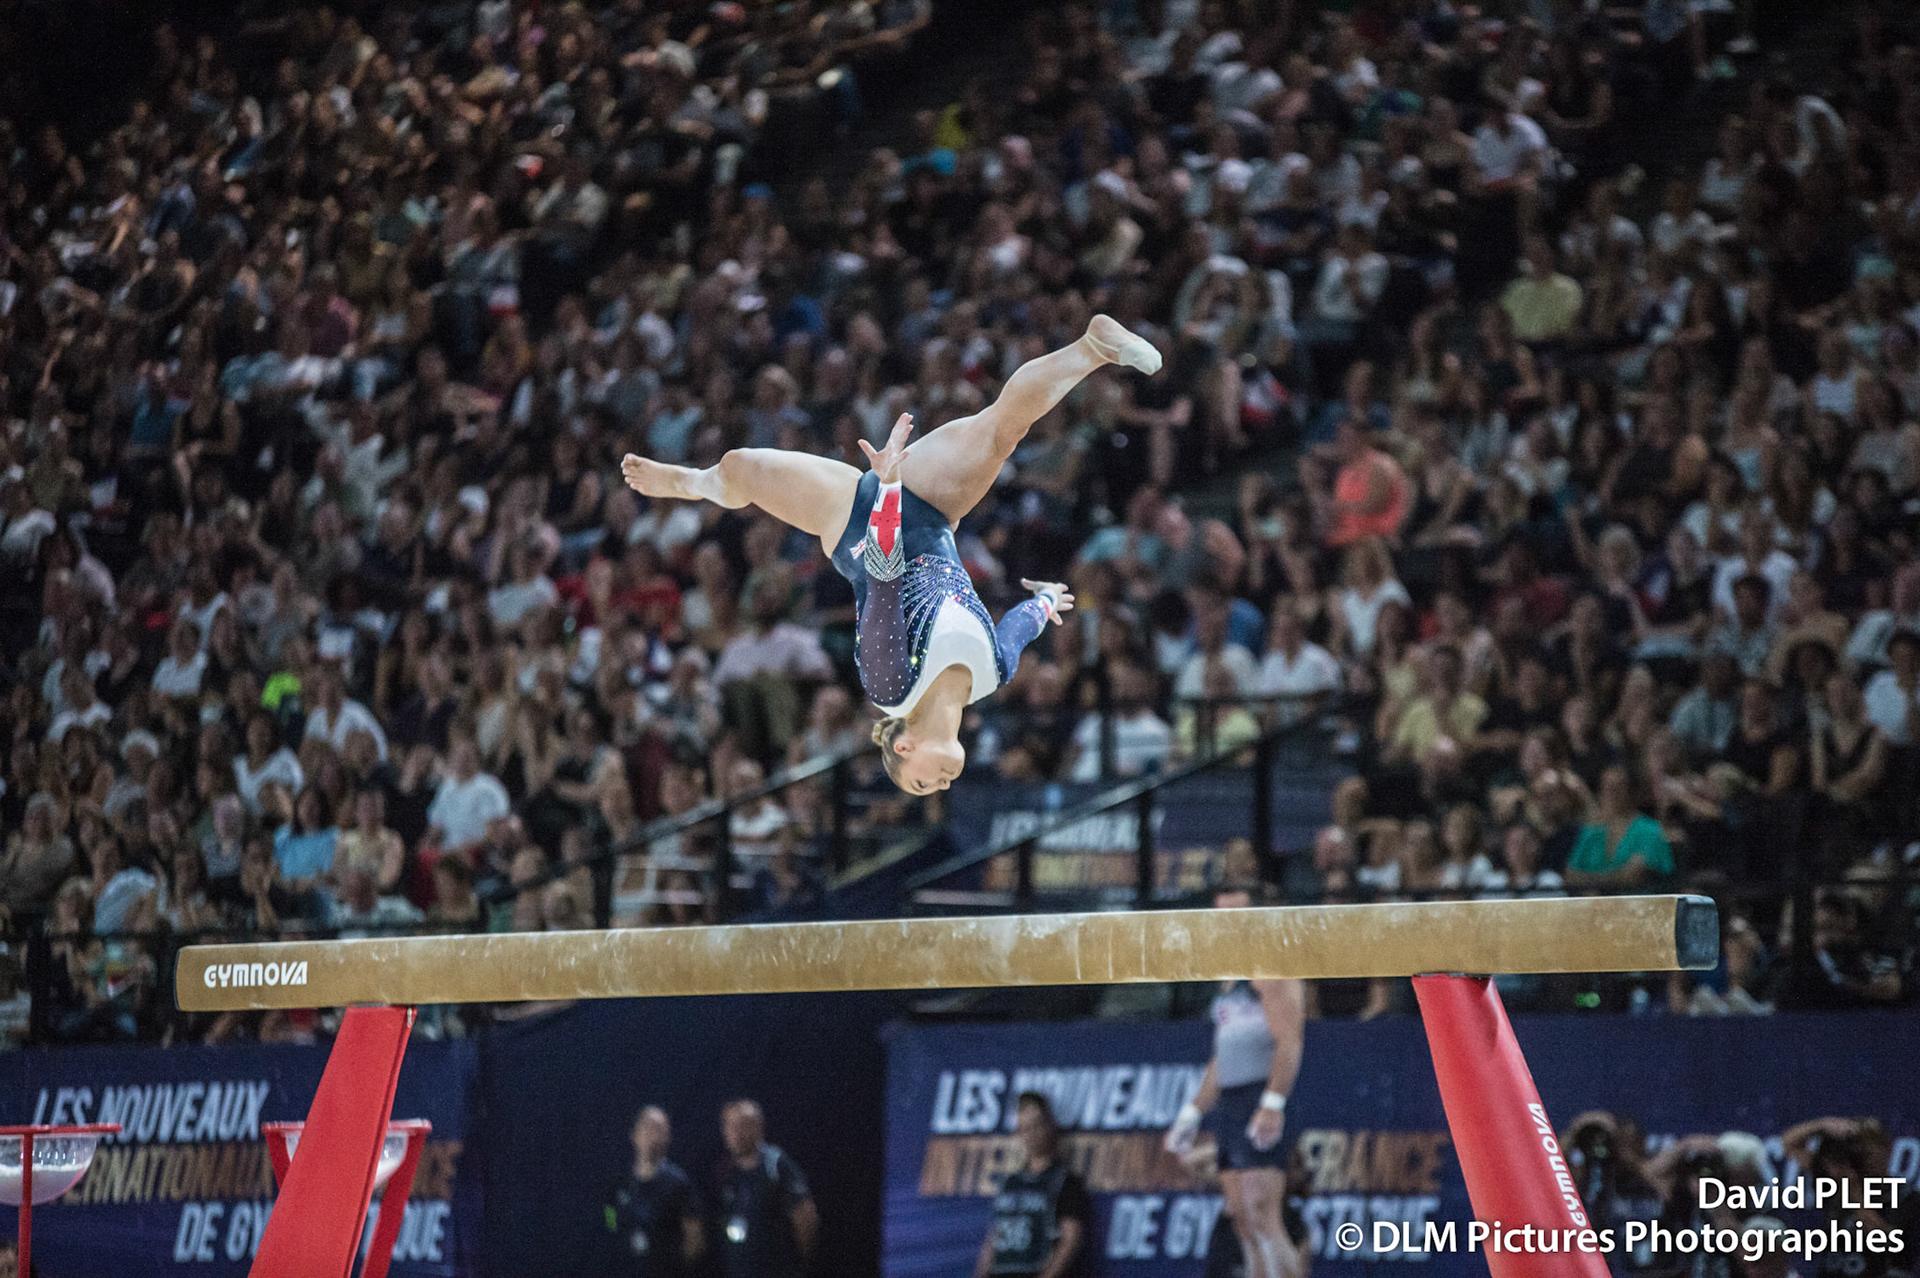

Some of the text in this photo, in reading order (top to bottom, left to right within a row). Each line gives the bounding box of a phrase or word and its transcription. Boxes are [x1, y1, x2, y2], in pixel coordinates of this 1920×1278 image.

[204, 961, 308, 988] GYMNOVA
[98, 1081, 269, 1144] NOUVEAUX
[931, 1070, 1006, 1133] LES
[1528, 1103, 1587, 1227] GYMNOVA
[174, 1202, 225, 1262] DE
[1108, 1195, 1165, 1259] DE
